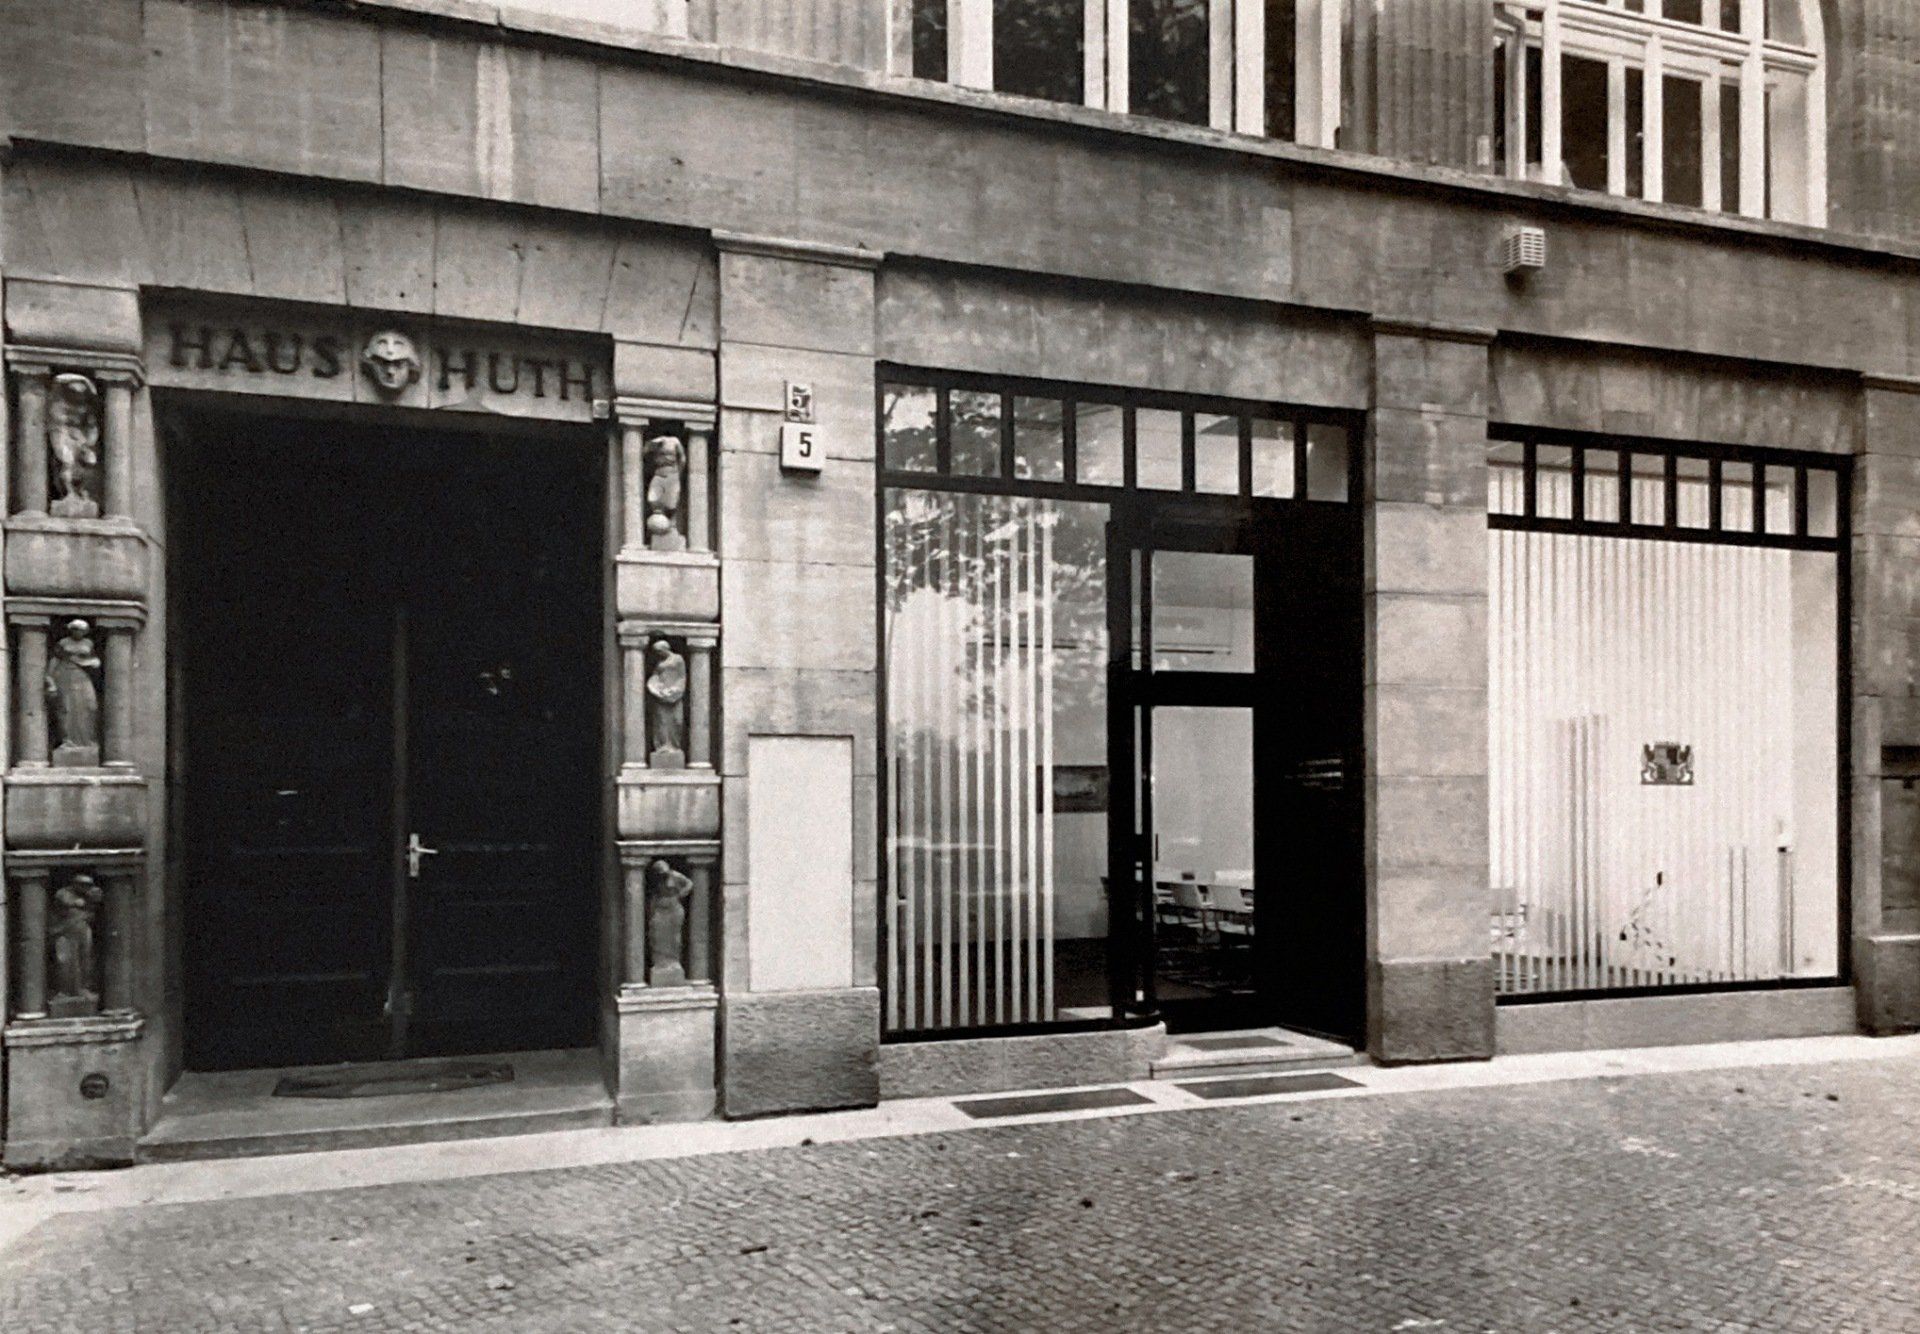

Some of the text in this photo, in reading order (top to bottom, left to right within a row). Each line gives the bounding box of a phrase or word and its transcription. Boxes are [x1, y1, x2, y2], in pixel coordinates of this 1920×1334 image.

[169, 326, 594, 402] HAUS HUTH
[799, 432, 812, 458] 5
